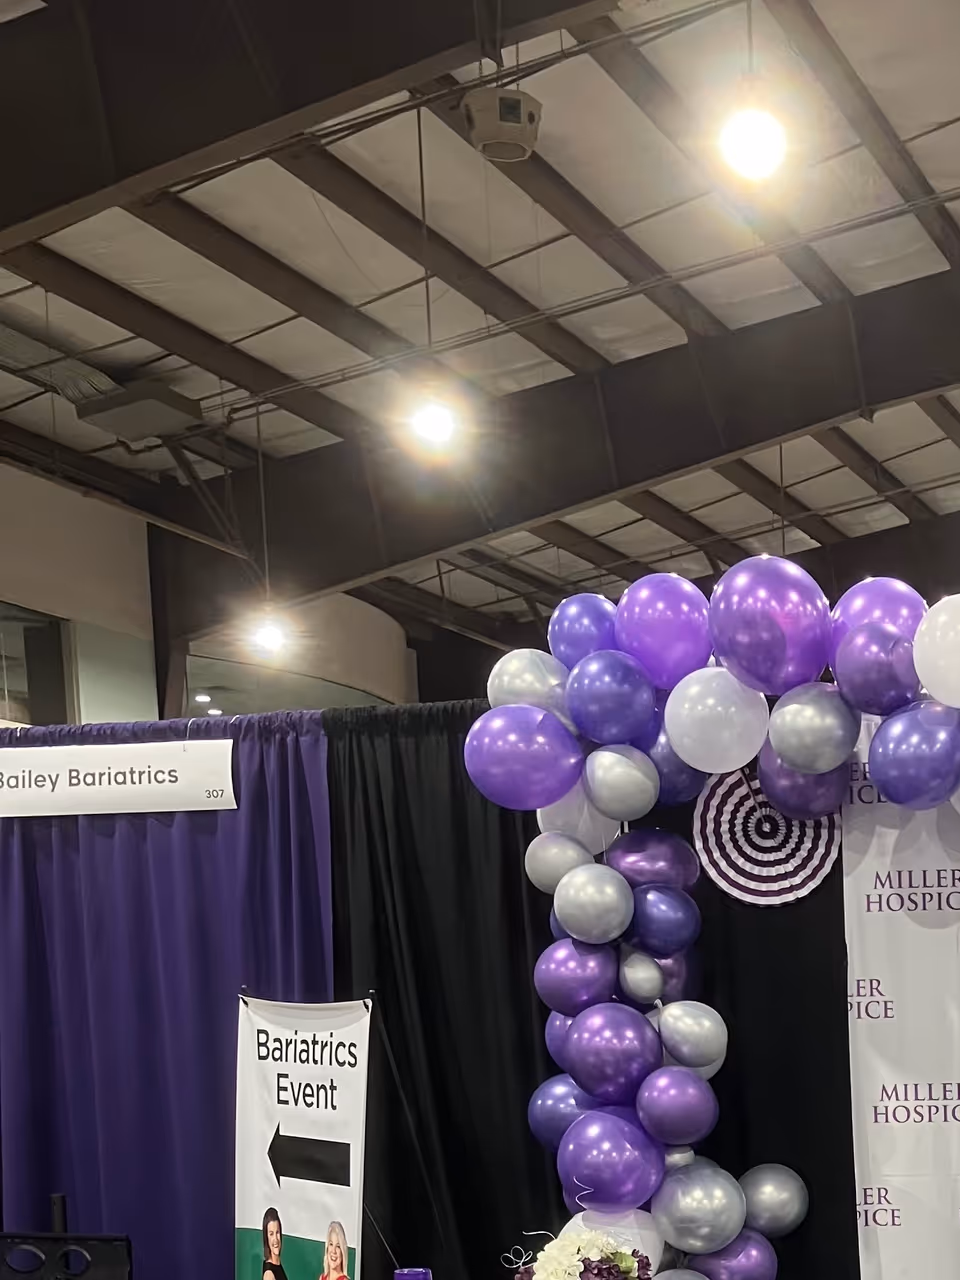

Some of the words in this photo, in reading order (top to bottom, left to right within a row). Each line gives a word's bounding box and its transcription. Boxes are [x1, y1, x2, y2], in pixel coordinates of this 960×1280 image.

[68, 765, 179, 787] Bariatrics
[204, 789, 225, 799] 307
[256, 1029, 358, 1068] Bariatrics
[276, 1073, 337, 1110] Event
